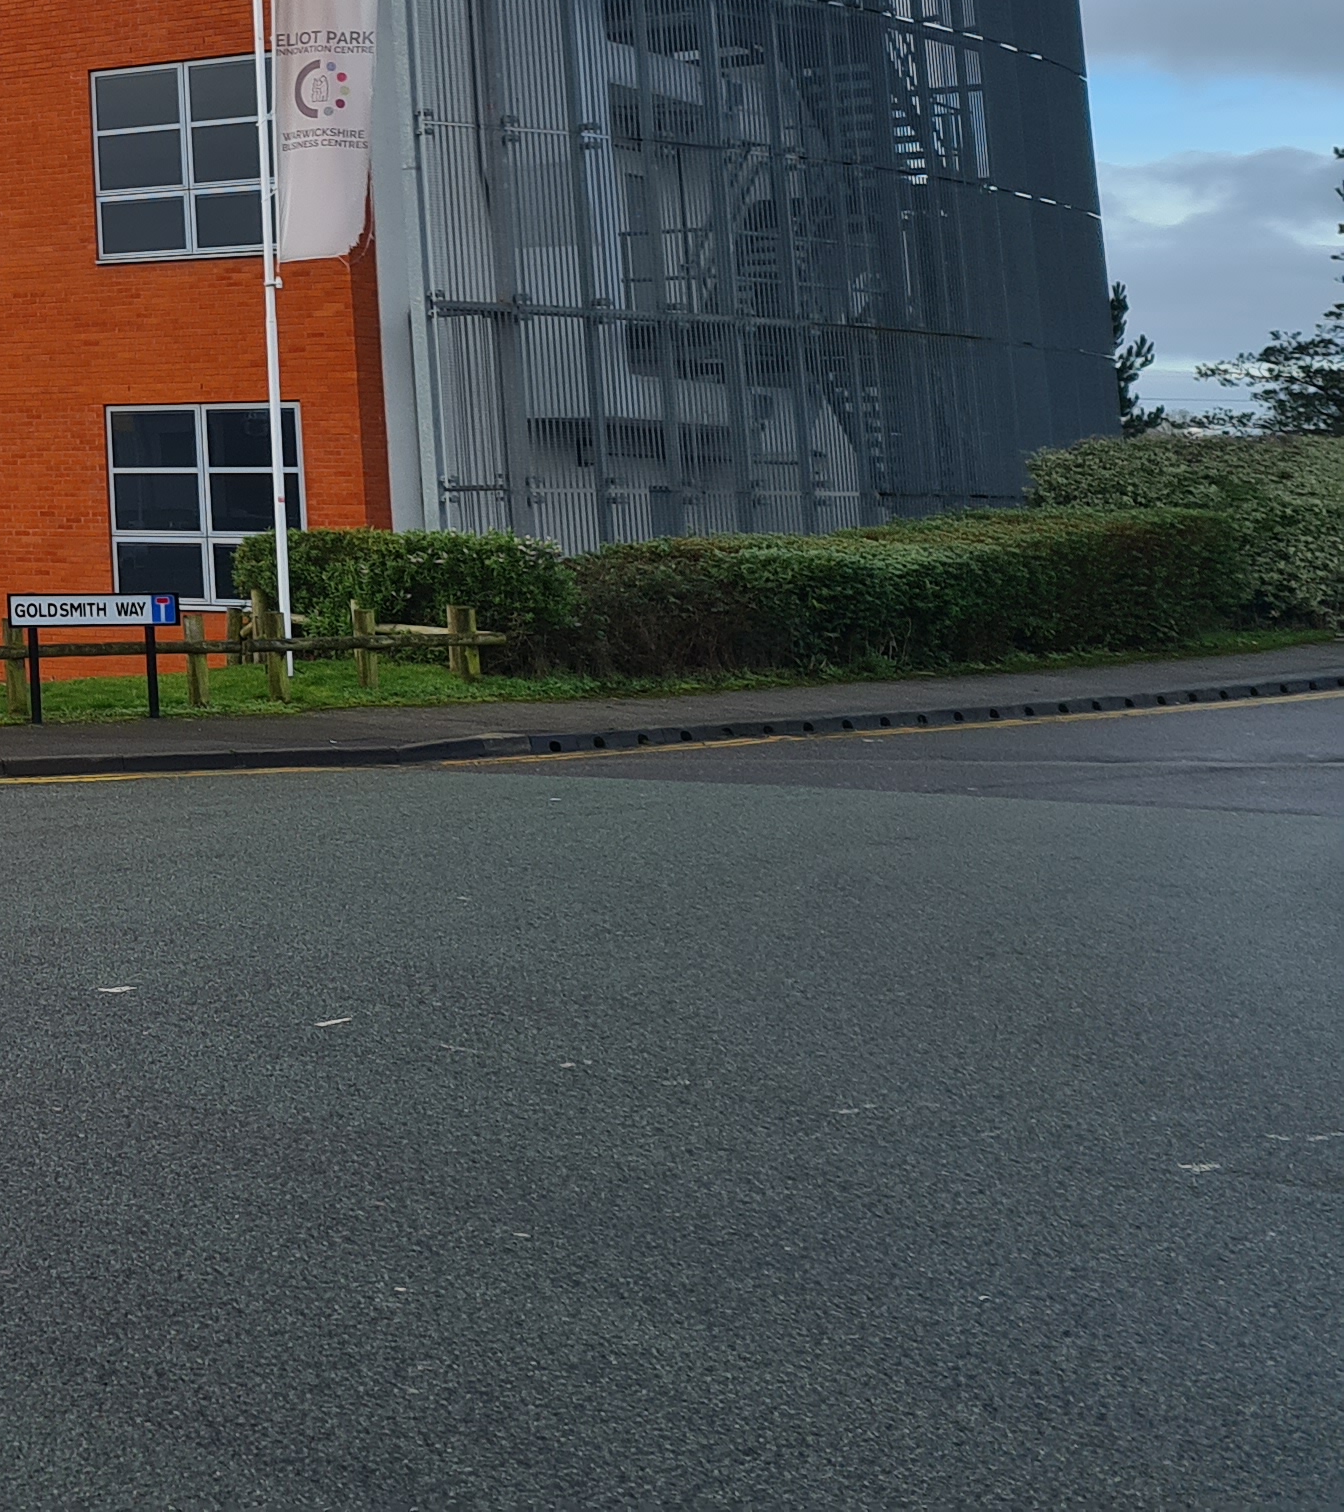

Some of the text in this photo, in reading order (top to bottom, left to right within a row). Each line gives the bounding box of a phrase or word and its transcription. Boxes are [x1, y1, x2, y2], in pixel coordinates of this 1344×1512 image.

[276, 30, 374, 47] ELIOT PARK
[276, 45, 374, 56] INNOVATION CENTRE
[282, 128, 365, 141] WARWICKSHIRE
[320, 138, 369, 149] CENTRES
[14, 601, 146, 618] GOLDSMITH WAY
